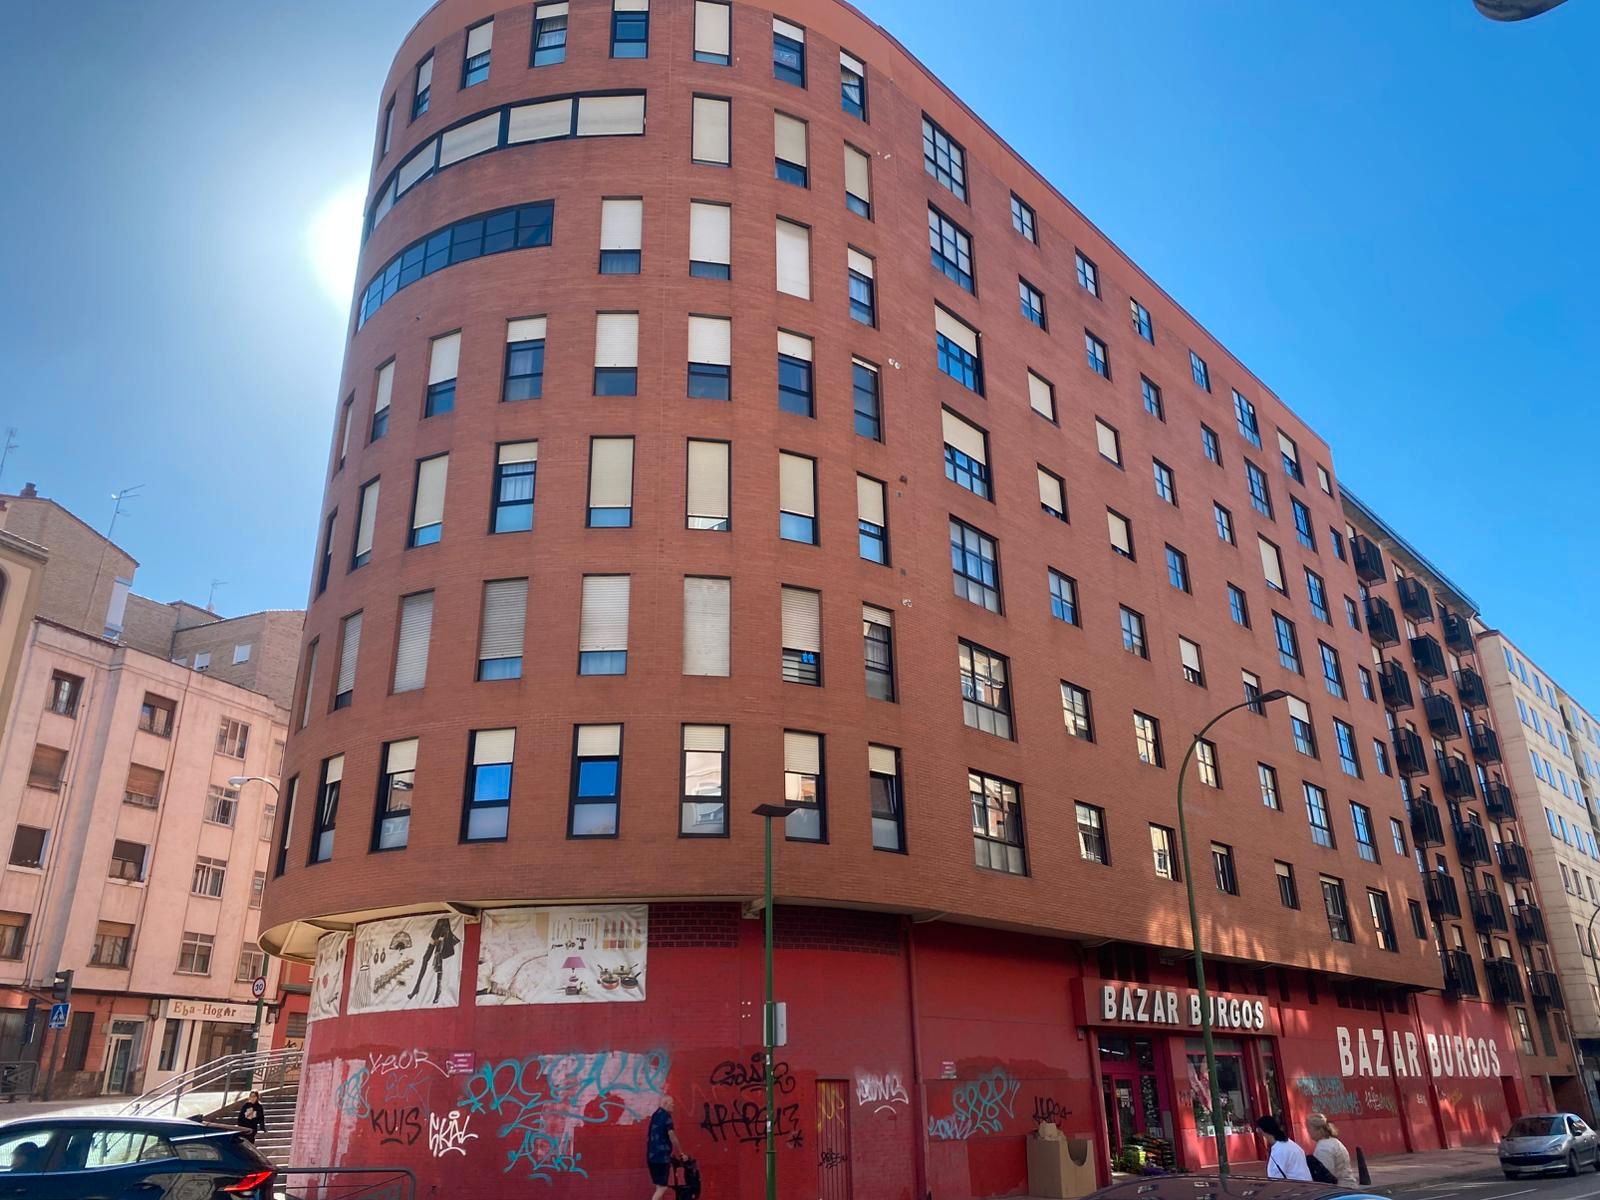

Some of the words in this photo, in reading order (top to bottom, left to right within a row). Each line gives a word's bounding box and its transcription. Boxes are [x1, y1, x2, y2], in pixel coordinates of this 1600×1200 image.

[1103, 985, 1180, 1025] BAZAR
[1336, 1026, 1422, 1077] BAZAR
[1427, 1033, 1500, 1077] BURGOS
